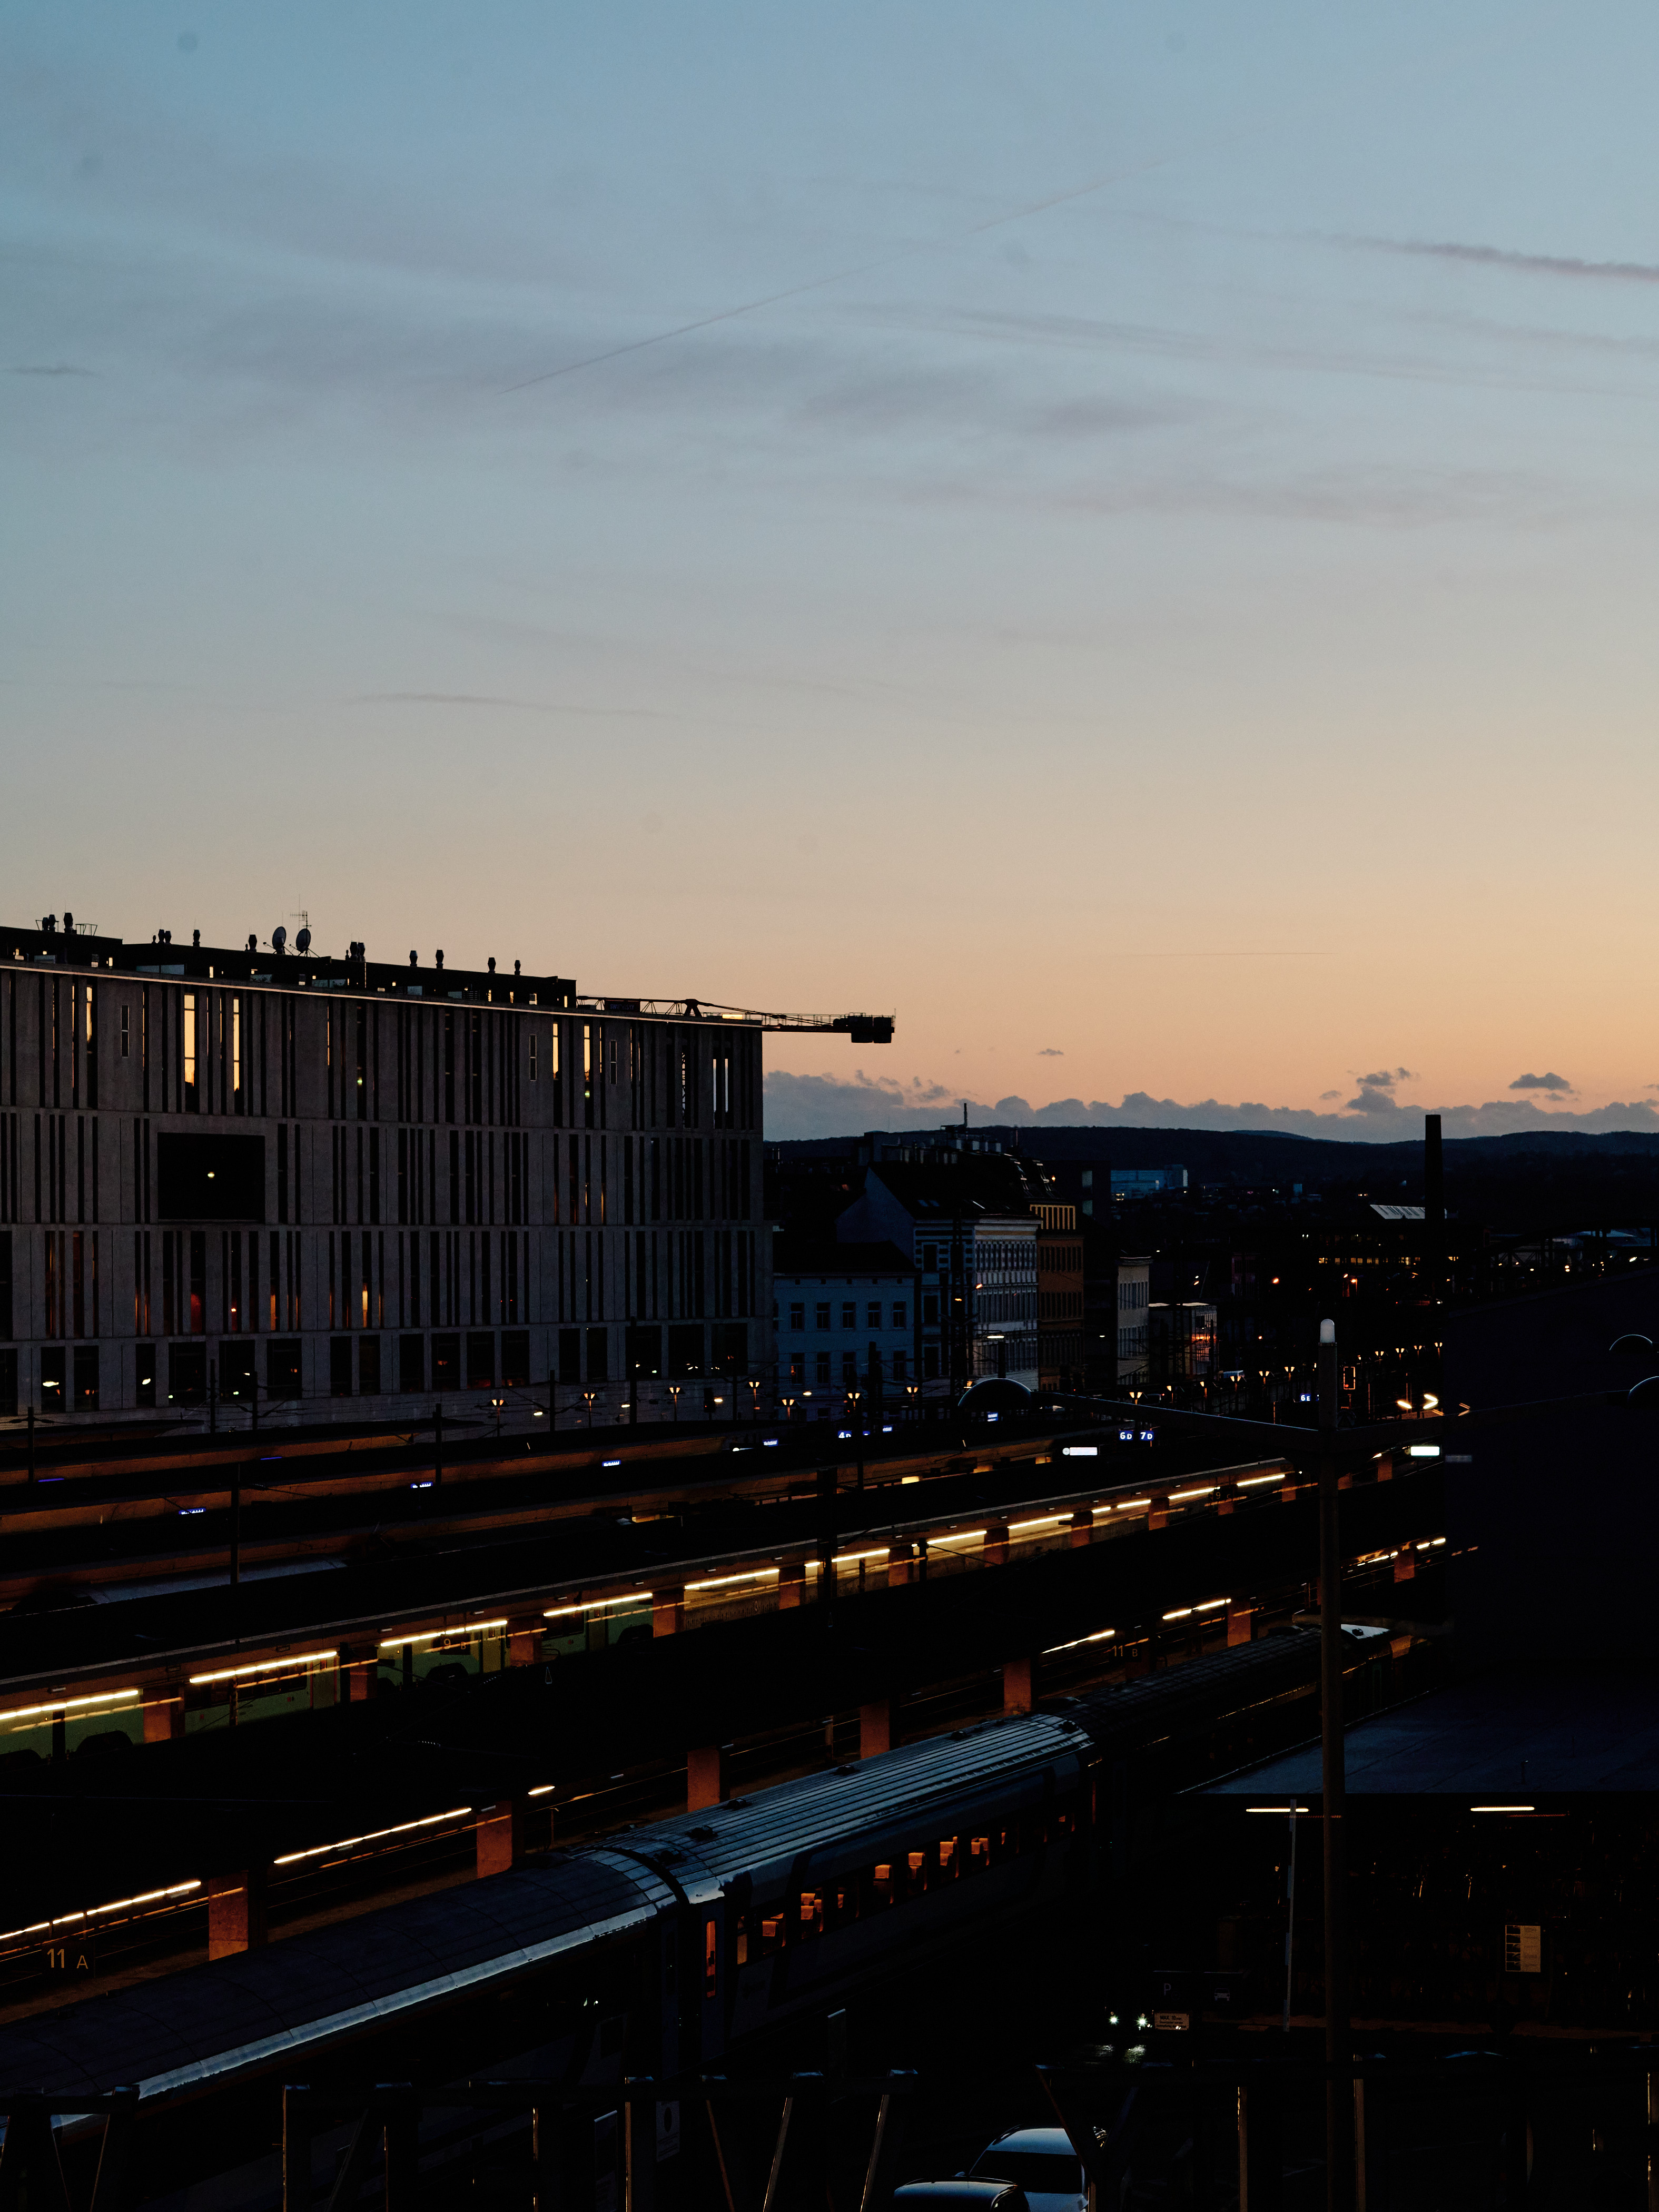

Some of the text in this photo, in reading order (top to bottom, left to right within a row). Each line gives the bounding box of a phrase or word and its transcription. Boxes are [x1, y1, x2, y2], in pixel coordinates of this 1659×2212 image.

[1112, 1645, 1138, 1657] 11 B
[47, 1948, 89, 1969] 11 A
